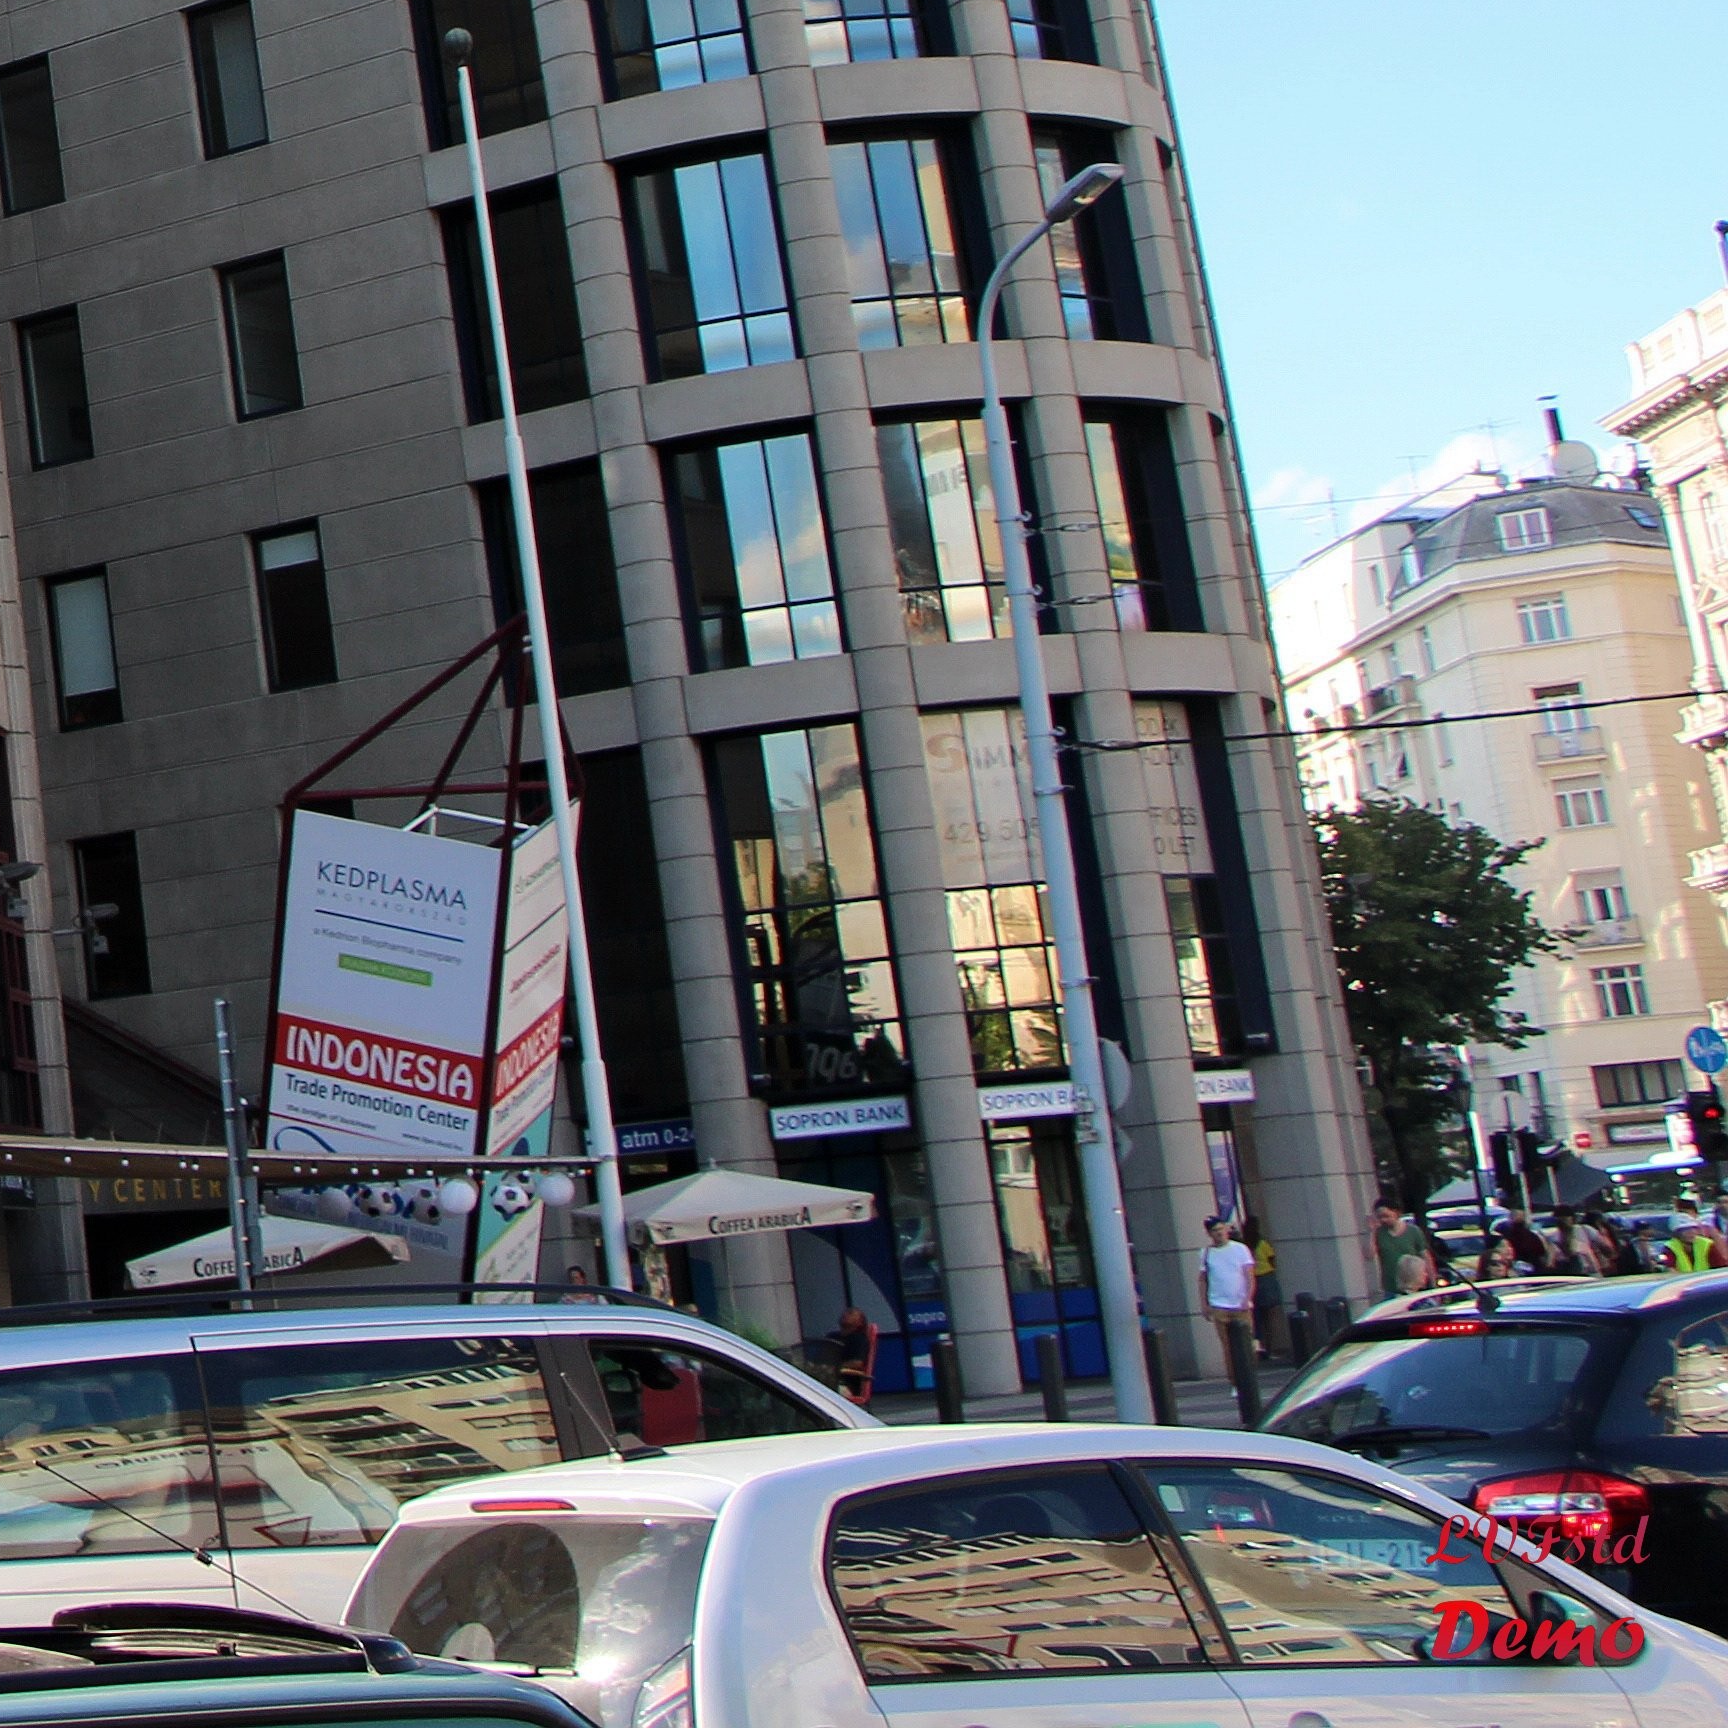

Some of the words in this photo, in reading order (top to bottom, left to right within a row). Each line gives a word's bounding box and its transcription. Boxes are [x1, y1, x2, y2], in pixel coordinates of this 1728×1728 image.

[317, 860, 467, 910] KEDPLASMA
[285, 1025, 474, 1101] INDONESIA
[1197, 1078, 1216, 1094] ON
[1219, 1076, 1251, 1093] BANK
[285, 1072, 328, 1101] Trade
[331, 1083, 413, 1119] Promotion
[417, 1104, 470, 1133] Center
[982, 1089, 1052, 1112] SOPRON
[775, 1111, 849, 1132] SOPRON
[856, 1103, 905, 1123] BANK
[621, 1131, 661, 1149] atm
[88, 1179, 103, 1203] Y
[113, 1176, 223, 1203] CENTER
[708, 1214, 756, 1236] COFFEA
[758, 1206, 812, 1230] ARABICA
[193, 1255, 236, 1278] COFFE
[264, 1246, 304, 1271] ABICA
[907, 1311, 947, 1325] sopro
